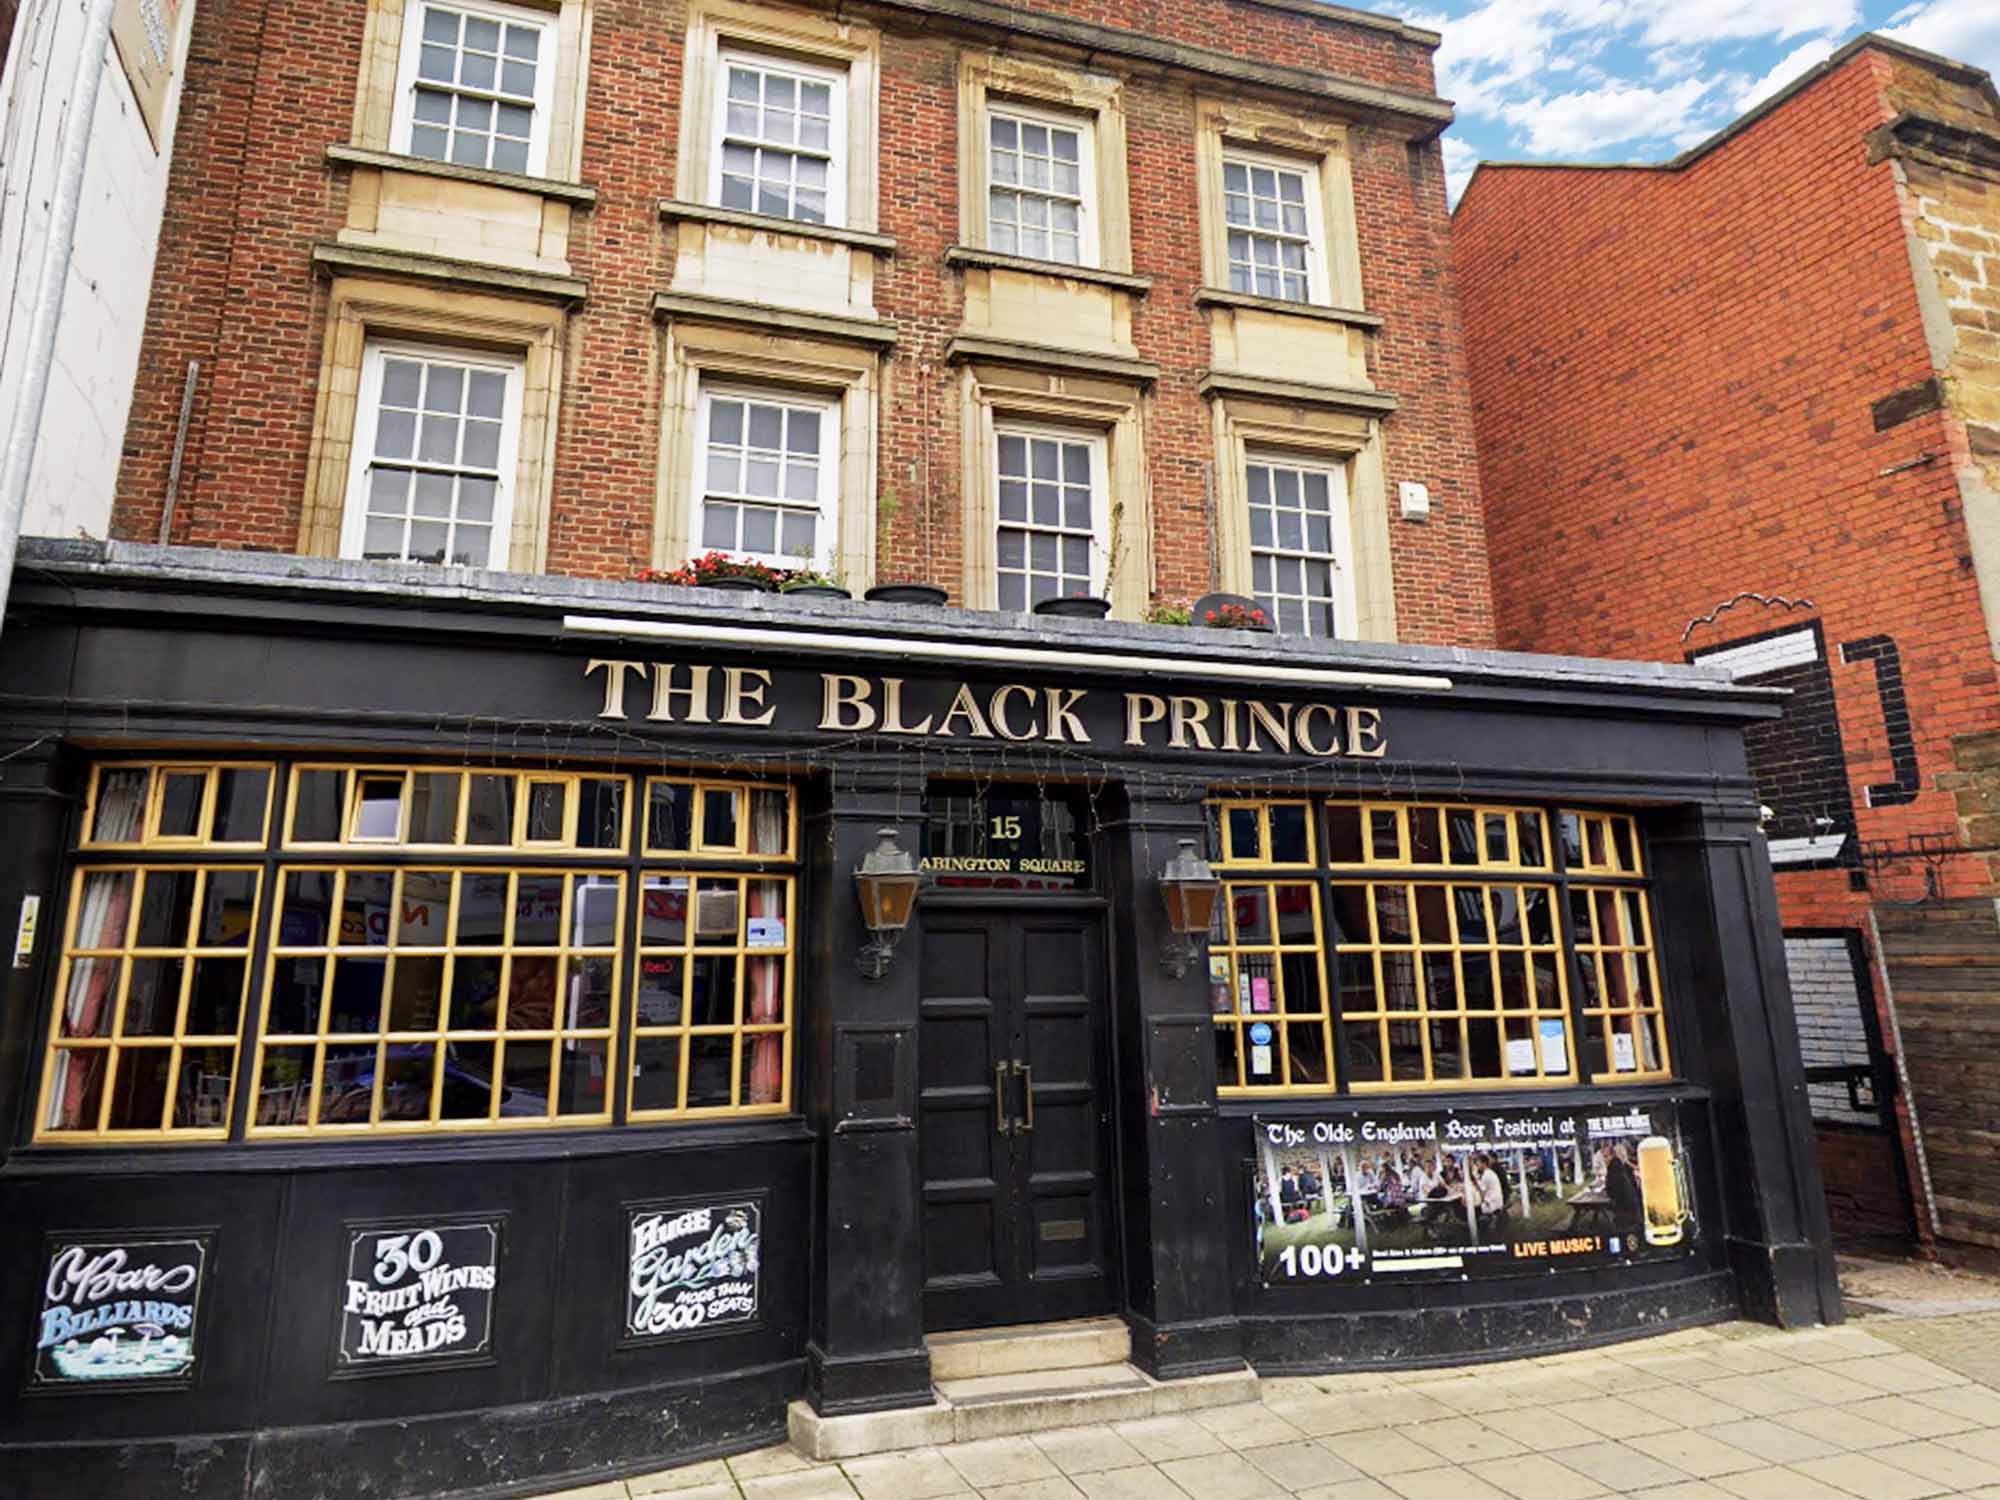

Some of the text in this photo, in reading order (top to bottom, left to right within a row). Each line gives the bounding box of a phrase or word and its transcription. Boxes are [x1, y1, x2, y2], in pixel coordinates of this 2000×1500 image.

[584, 659, 1388, 758] THE BLACK PRINCE
[990, 815, 1023, 840] 15
[919, 856, 1086, 873] ABINGTON SQUARE
[1267, 1116, 1576, 1147] The Olde England Beer Festival at
[373, 1230, 443, 1285] 30
[1278, 1243, 1366, 1277] 100+
[1513, 1242, 1548, 1257] LIVE
[1551, 1237, 1594, 1255] MUSIC
[344, 1263, 497, 1317] FRUIT WINES
[631, 1223, 760, 1329] Garden
[36, 1299, 193, 1349] BILLIARDS
[403, 1295, 460, 1327] and
[648, 1296, 754, 1335] 300 SEATS
[357, 1314, 468, 1356] MEADS
